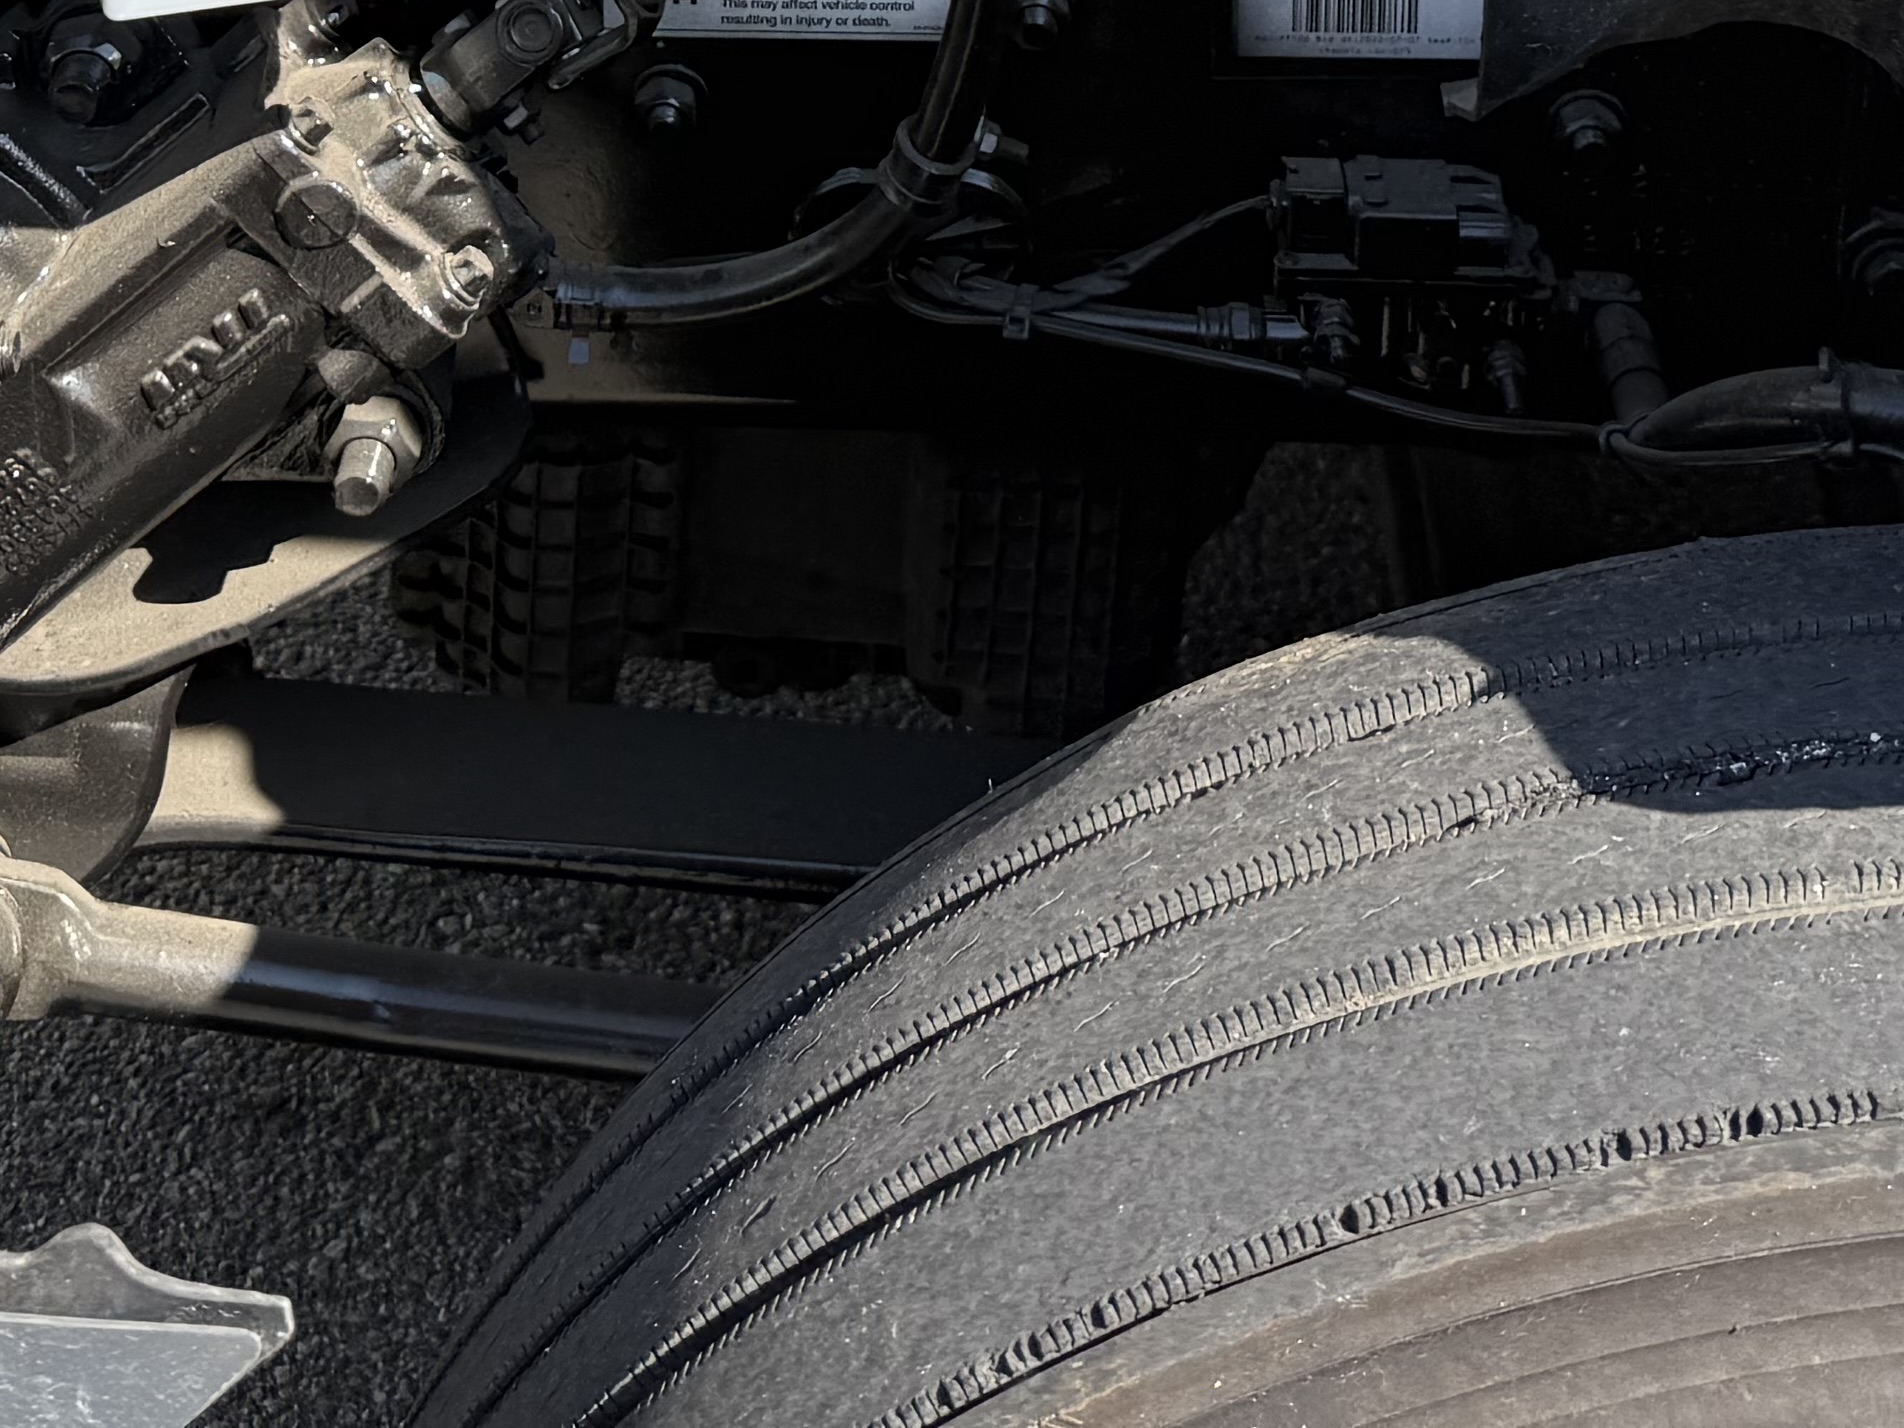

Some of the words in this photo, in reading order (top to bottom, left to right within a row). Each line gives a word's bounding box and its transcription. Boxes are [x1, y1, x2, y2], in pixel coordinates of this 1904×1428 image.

[751, 0, 778, 12] may
[781, 0, 818, 10] affect
[821, 0, 867, 11] vehicle
[869, 0, 915, 12] control
[720, 14, 777, 27] resulting
[780, 14, 793, 26] in
[795, 15, 832, 29] injury
[835, 16, 849, 27] or
[852, 16, 891, 27] death.
